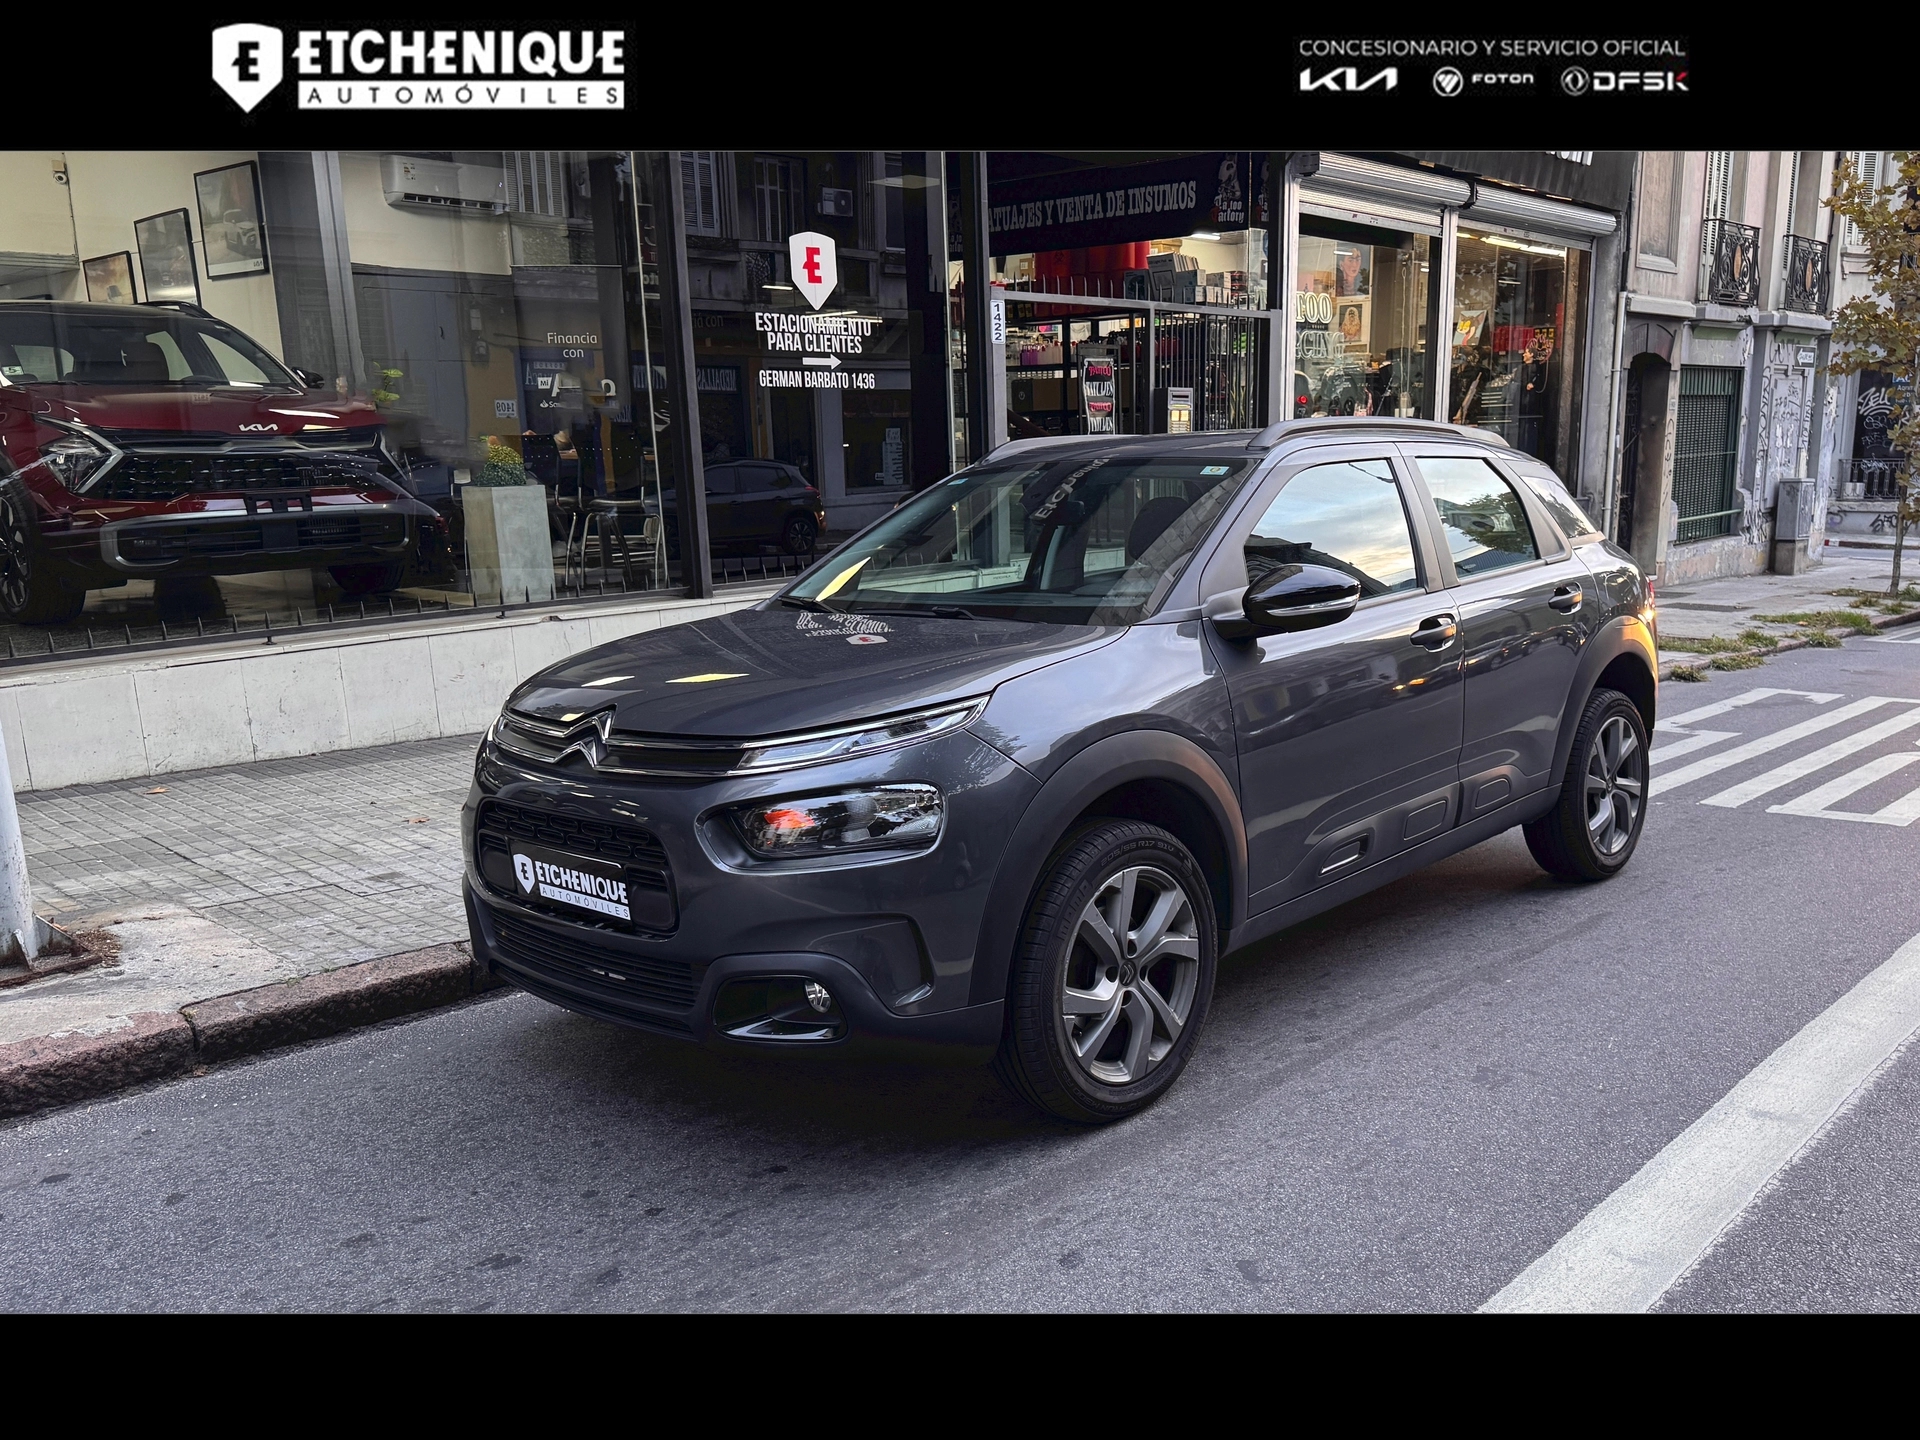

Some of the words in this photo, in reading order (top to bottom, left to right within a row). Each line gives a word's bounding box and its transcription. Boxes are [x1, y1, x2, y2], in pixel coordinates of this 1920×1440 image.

[1044, 200, 1054, 226] Y
[1055, 193, 1104, 224] VENTA
[1106, 190, 1125, 218] DE
[1127, 180, 1197, 215] INSUMOS
[755, 312, 872, 337] ESTACIONAMIENTO
[993, 303, 1003, 341] 1422
[547, 332, 598, 344] Financia
[767, 332, 802, 352] PARA
[804, 334, 863, 354] CLIENTES
[562, 349, 585, 358] con
[759, 369, 801, 388] GERMAN
[804, 370, 849, 389] BARBATO
[851, 373, 876, 389] 1436
[534, 860, 629, 905] ETCHENIQUE
[541, 886, 630, 918] AUTOMÓVILES
